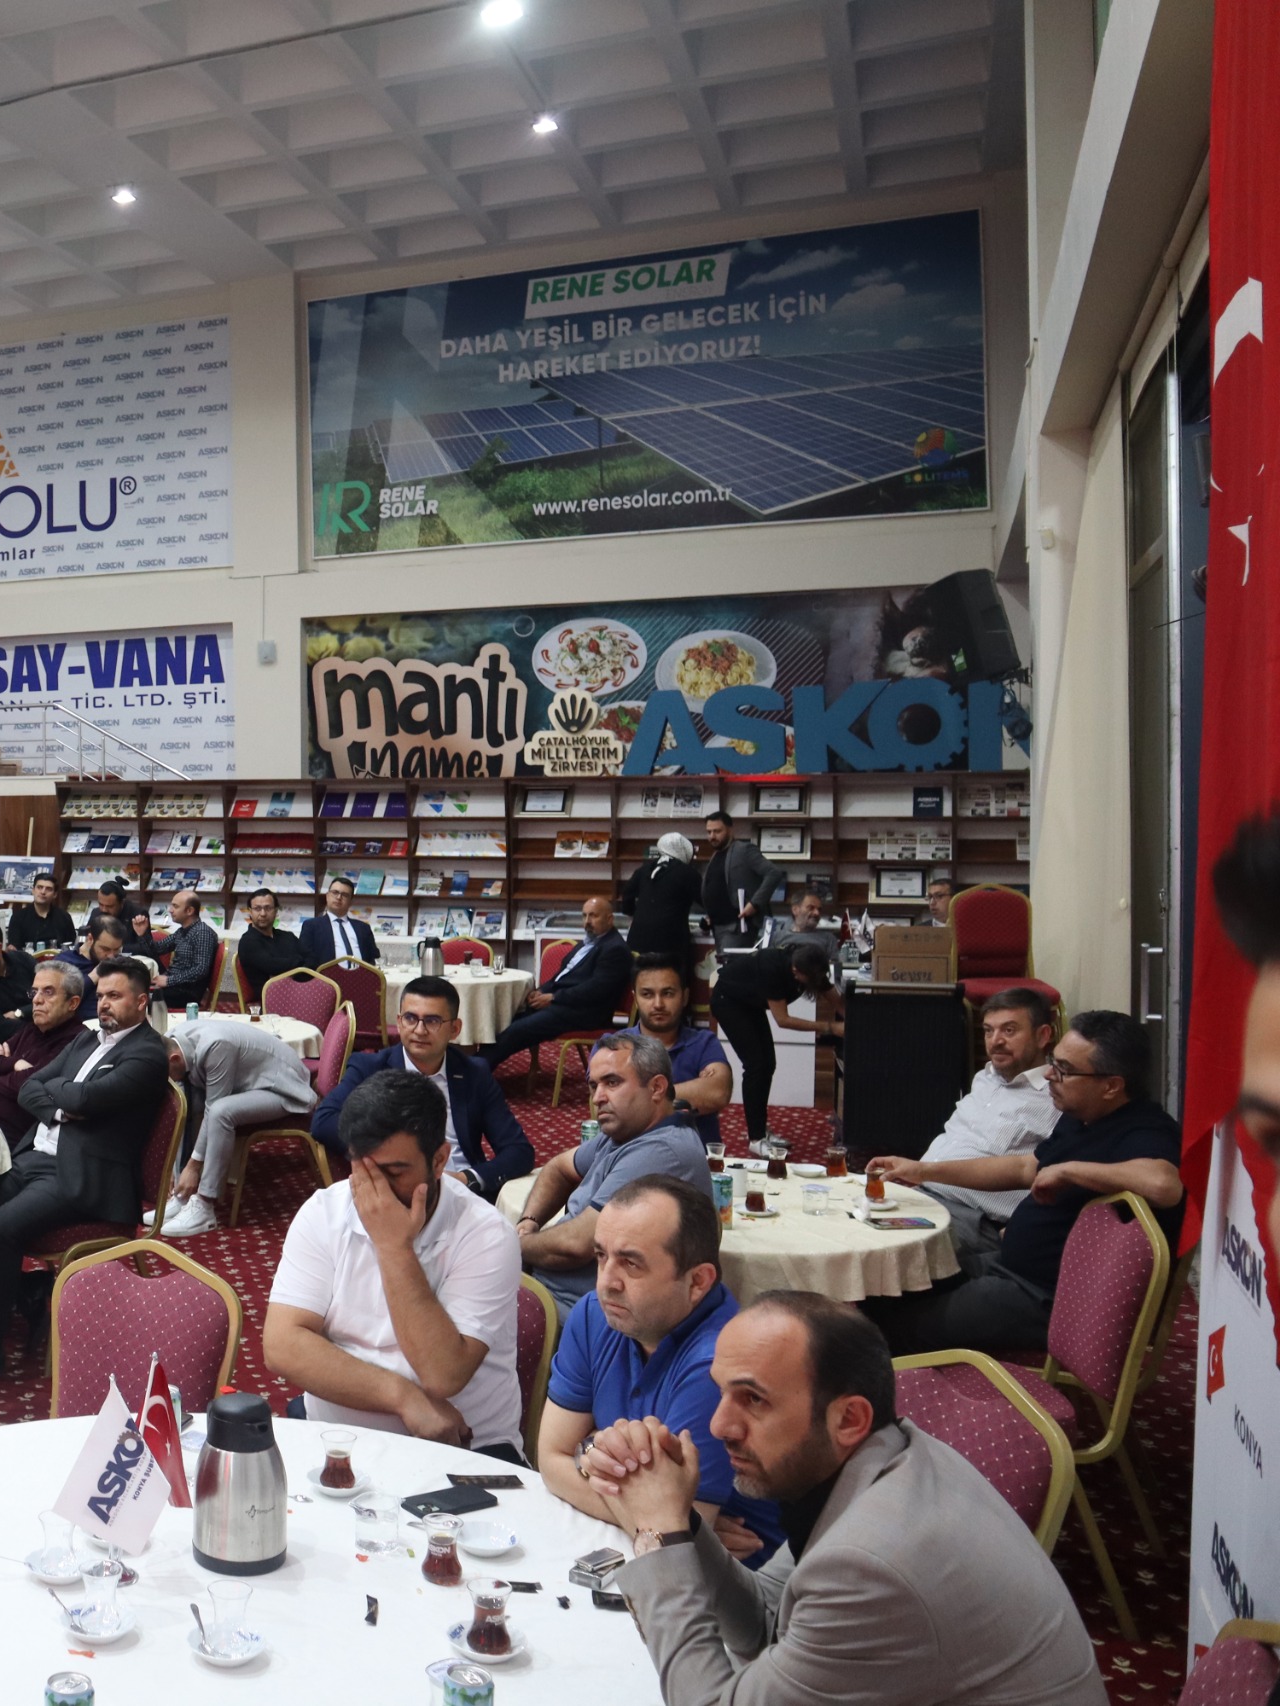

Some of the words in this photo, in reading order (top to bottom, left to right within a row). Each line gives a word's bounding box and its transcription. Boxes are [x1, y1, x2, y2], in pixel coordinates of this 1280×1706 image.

[531, 273, 603, 305] RENE
[613, 258, 717, 293] SOLAR
[440, 329, 509, 359] DAHA
[514, 319, 585, 351] YEŞİL
[592, 314, 632, 341] BİR
[640, 301, 761, 333] GELECEK
[768, 290, 827, 321] İÇİN
[498, 352, 616, 384] HAREKET
[619, 335, 762, 370] EDİYORUZ!
[142, 474, 165, 483] SKON
[379, 485, 426, 503] RENE
[532, 487, 732, 516] www.renesolar.com.tr
[379, 500, 438, 519] SOLAR
[42, 544, 64, 554] SKON
[70, 692, 112, 710] TİC.
[123, 693, 172, 708] LTD.
[183, 687, 226, 709] ŞTİ.
[92, 719, 120, 728] ASKON
[132, 717, 160, 726] ASKON
[173, 716, 202, 725] ASKON
[160, 741, 190, 750] ASKON
[203, 741, 234, 749] ASKON
[572, 747, 618, 760] TARIM
[182, 764, 213, 772] ASKON
[1222, 1216, 1262, 1308] ASKON
[1234, 1403, 1263, 1479] KONYA
[132, 1478, 147, 1501] KONYA
